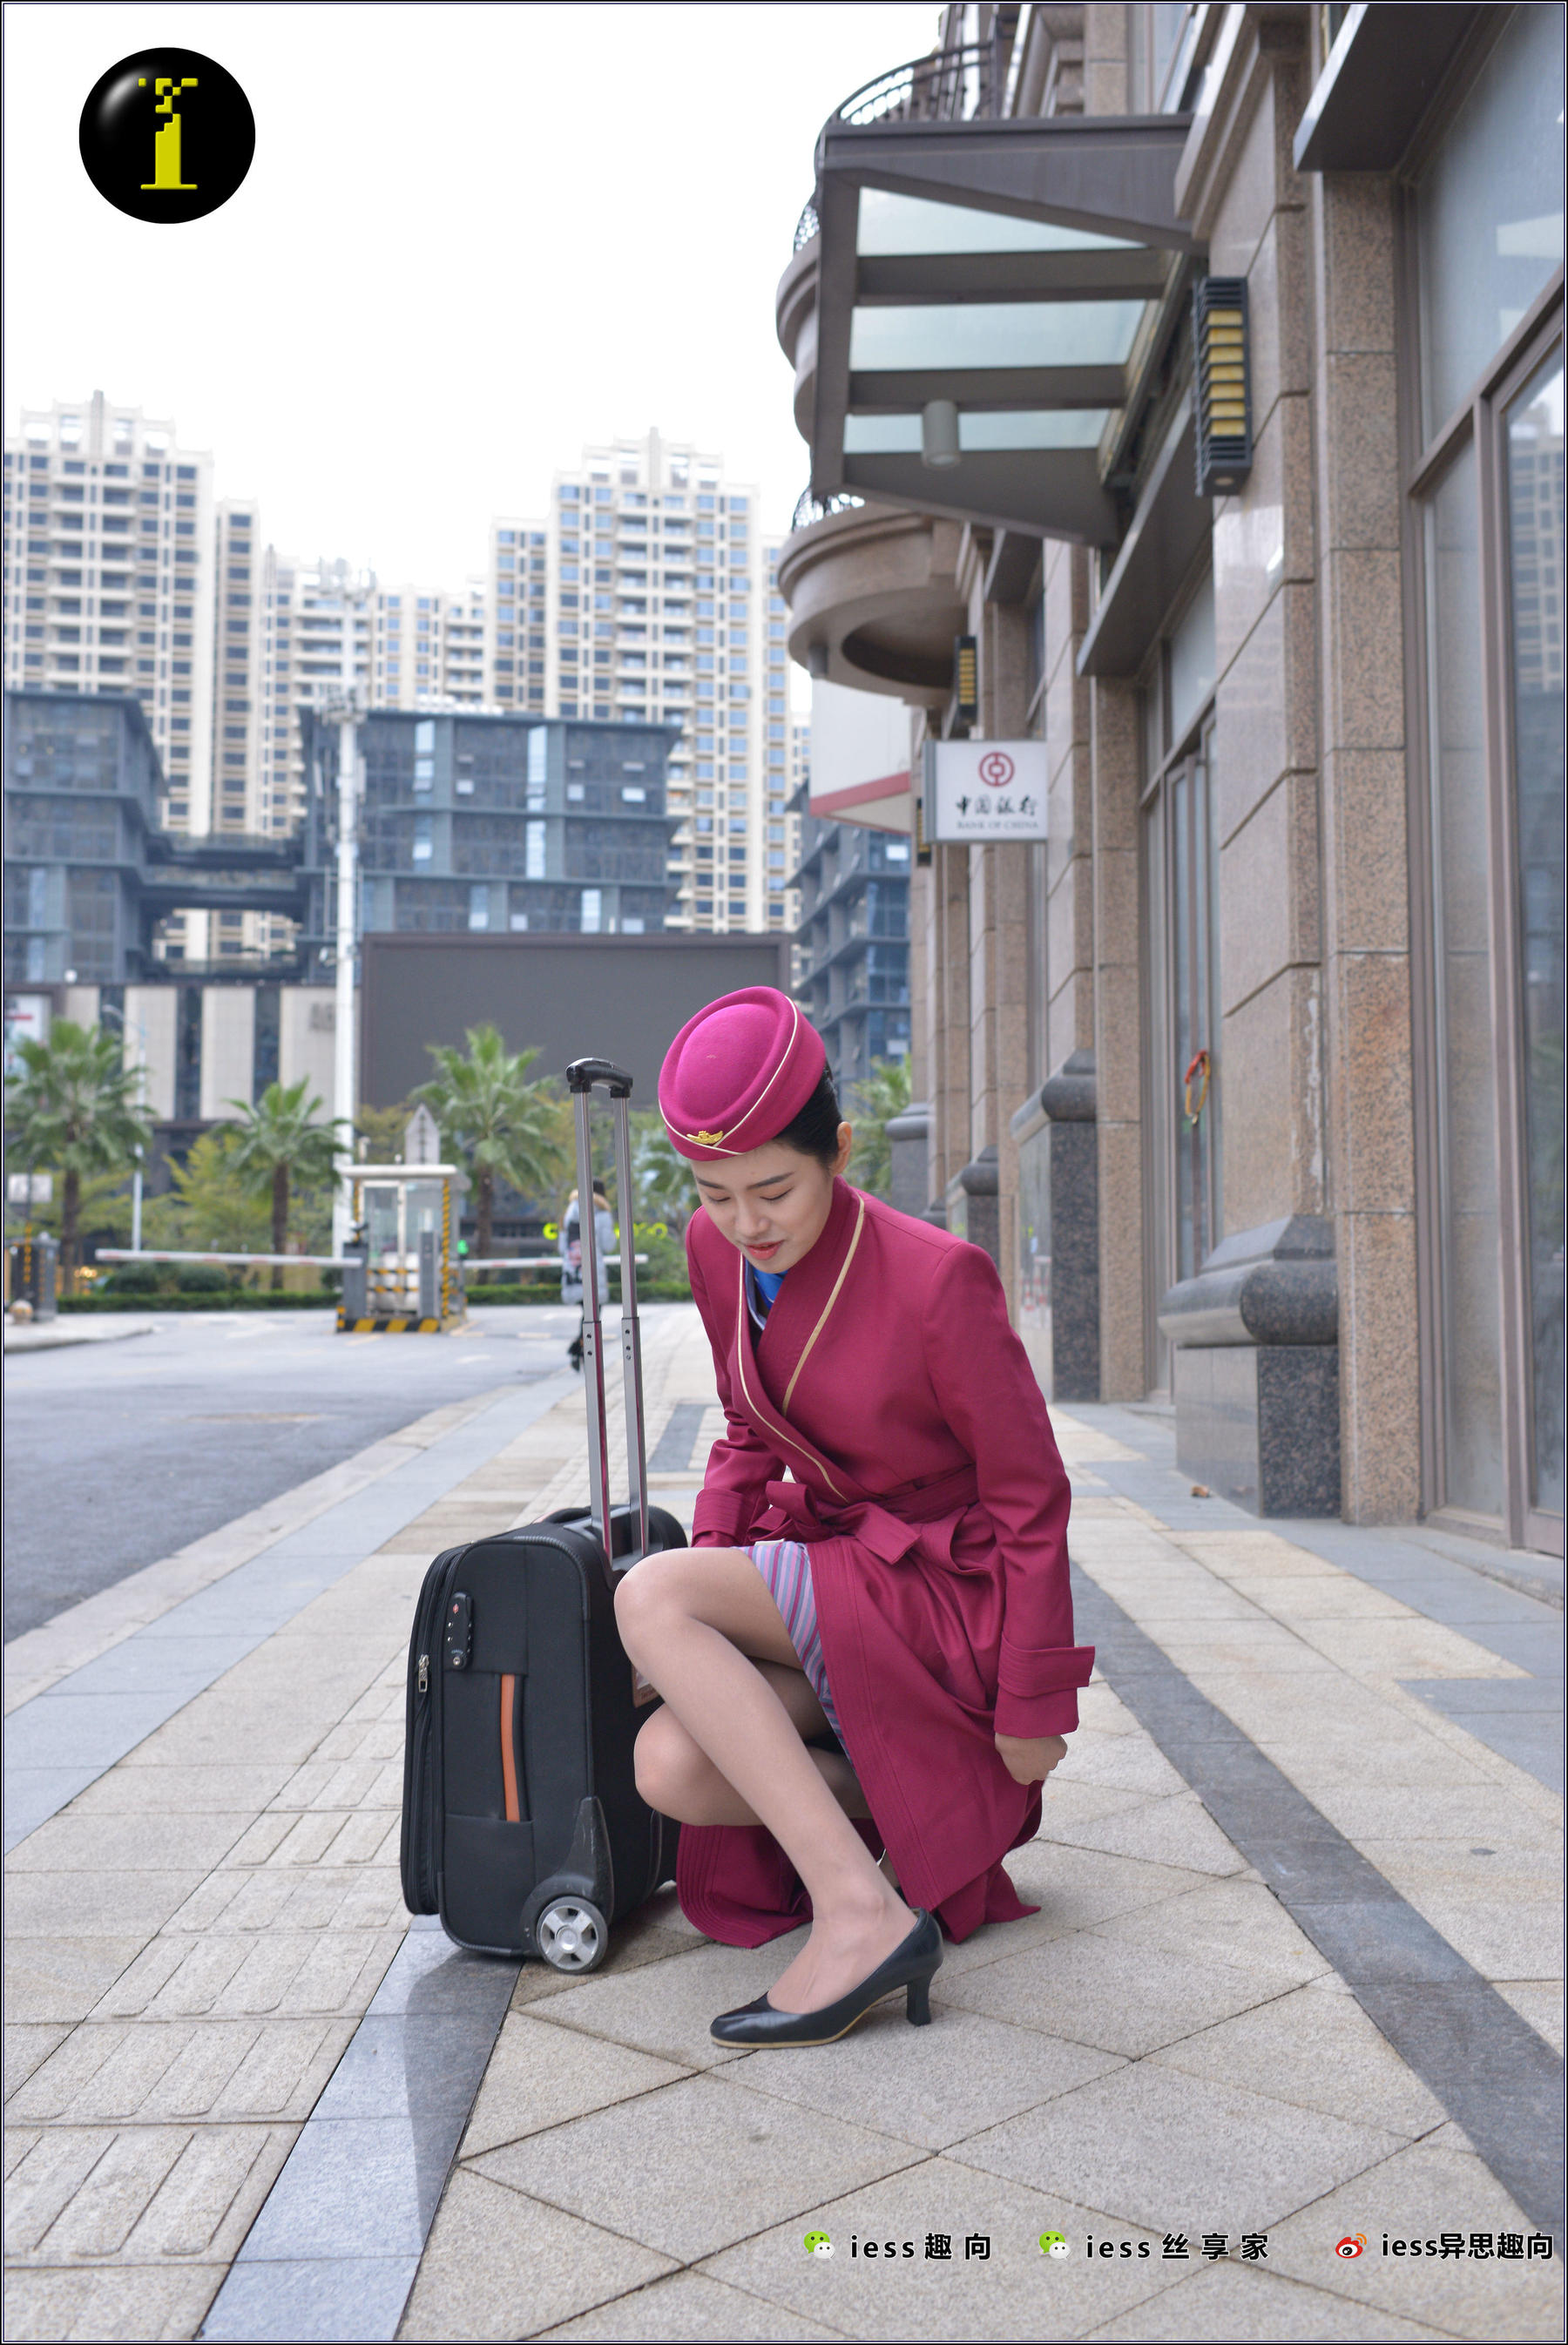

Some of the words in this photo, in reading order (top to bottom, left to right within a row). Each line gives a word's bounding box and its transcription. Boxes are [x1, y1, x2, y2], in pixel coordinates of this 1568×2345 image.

[956, 794, 1037, 817] 中国银行
[956, 821, 985, 829] BANK
[1004, 821, 1038, 829] CHINA
